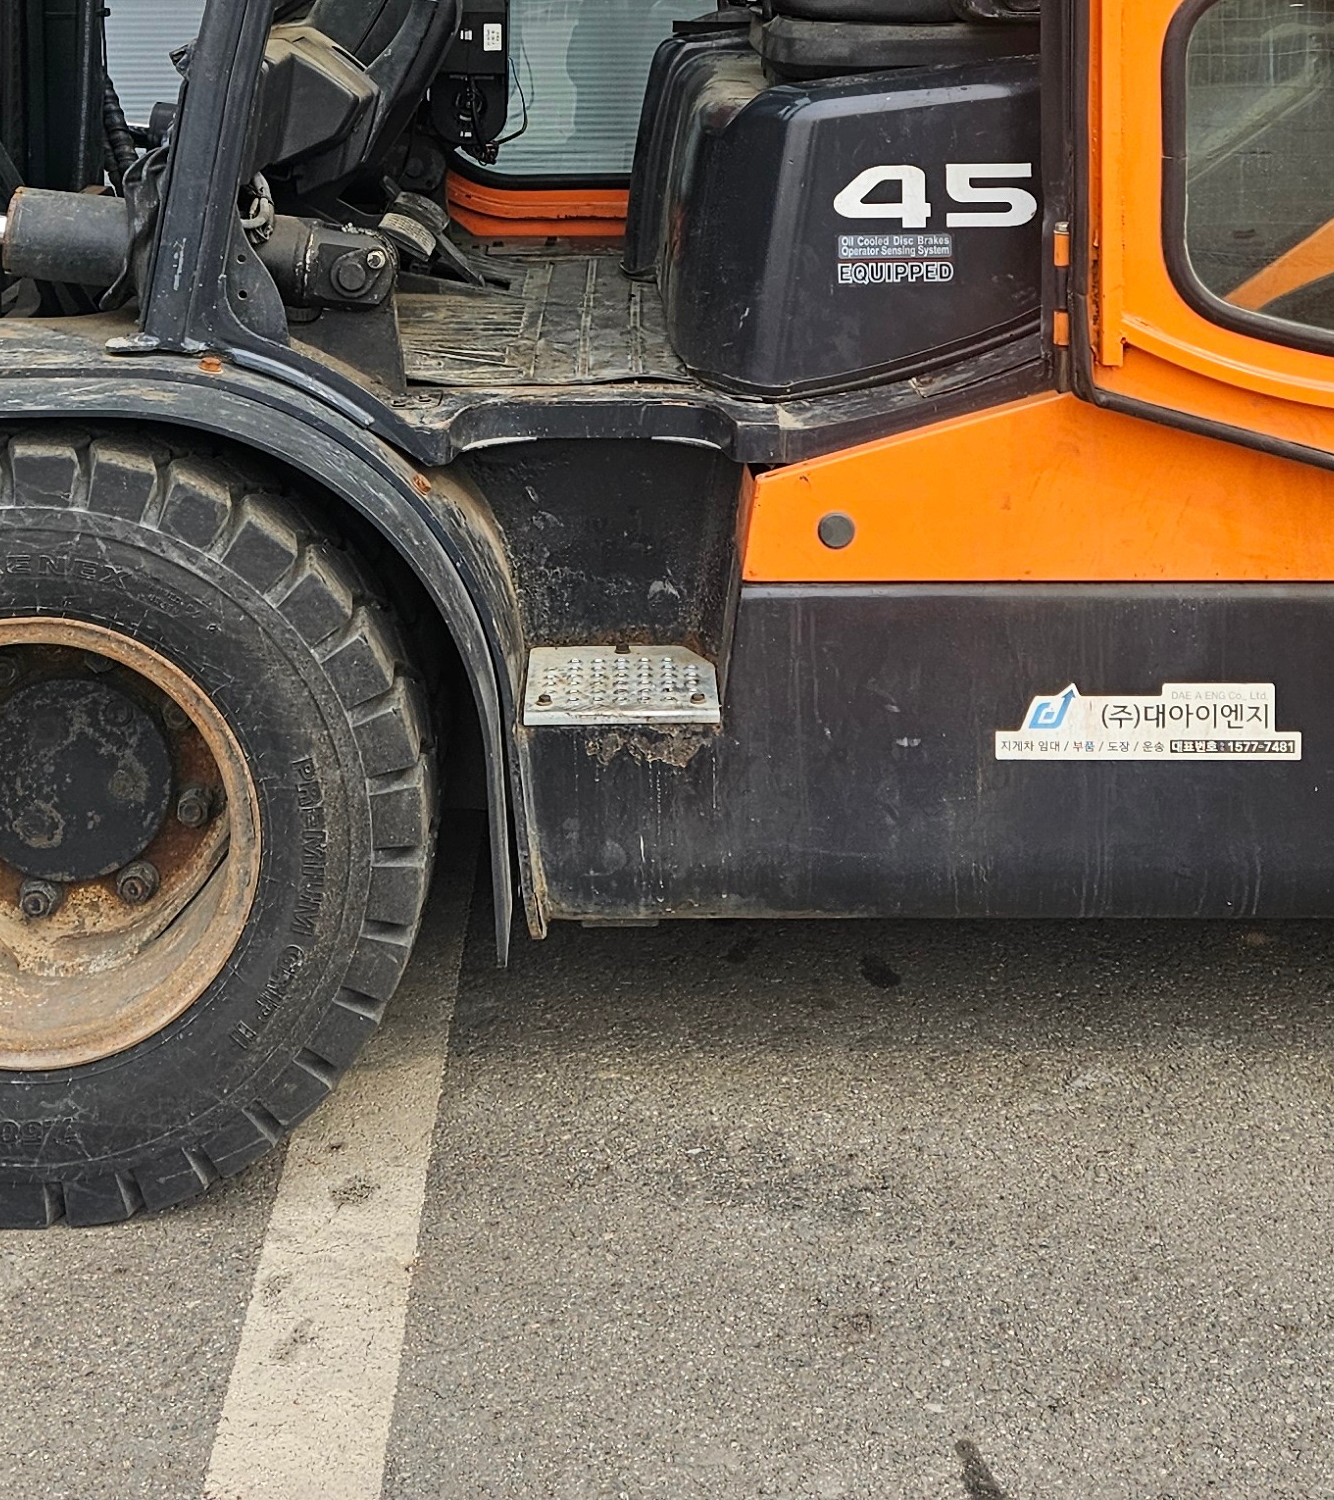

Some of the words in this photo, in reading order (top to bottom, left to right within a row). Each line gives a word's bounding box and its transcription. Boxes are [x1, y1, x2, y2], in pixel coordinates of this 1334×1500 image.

[833, 162, 1037, 228] 45
[842, 236, 854, 246] Oil
[857, 236, 889, 246] Cooled
[893, 236, 913, 246] Disc
[917, 235, 950, 245] Brakes
[841, 246, 879, 257] Operator
[881, 246, 916, 257] Sensing
[917, 245, 950, 256] System
[838, 262, 954, 285] EQUIPPED
[1171, 691, 1192, 700] DAE
[1195, 691, 1202, 700] A
[1205, 691, 1226, 700] ENG
[1102, 703, 1268, 729] (주)대아이엔지
[1001, 740, 1034, 752] 지게차
[1038, 740, 1060, 752] 임대
[1073, 740, 1095, 752] 부품
[1108, 740, 1130, 752] 도장
[1142, 740, 1165, 752] 운송
[1227, 741, 1294, 752] 1577-7481
